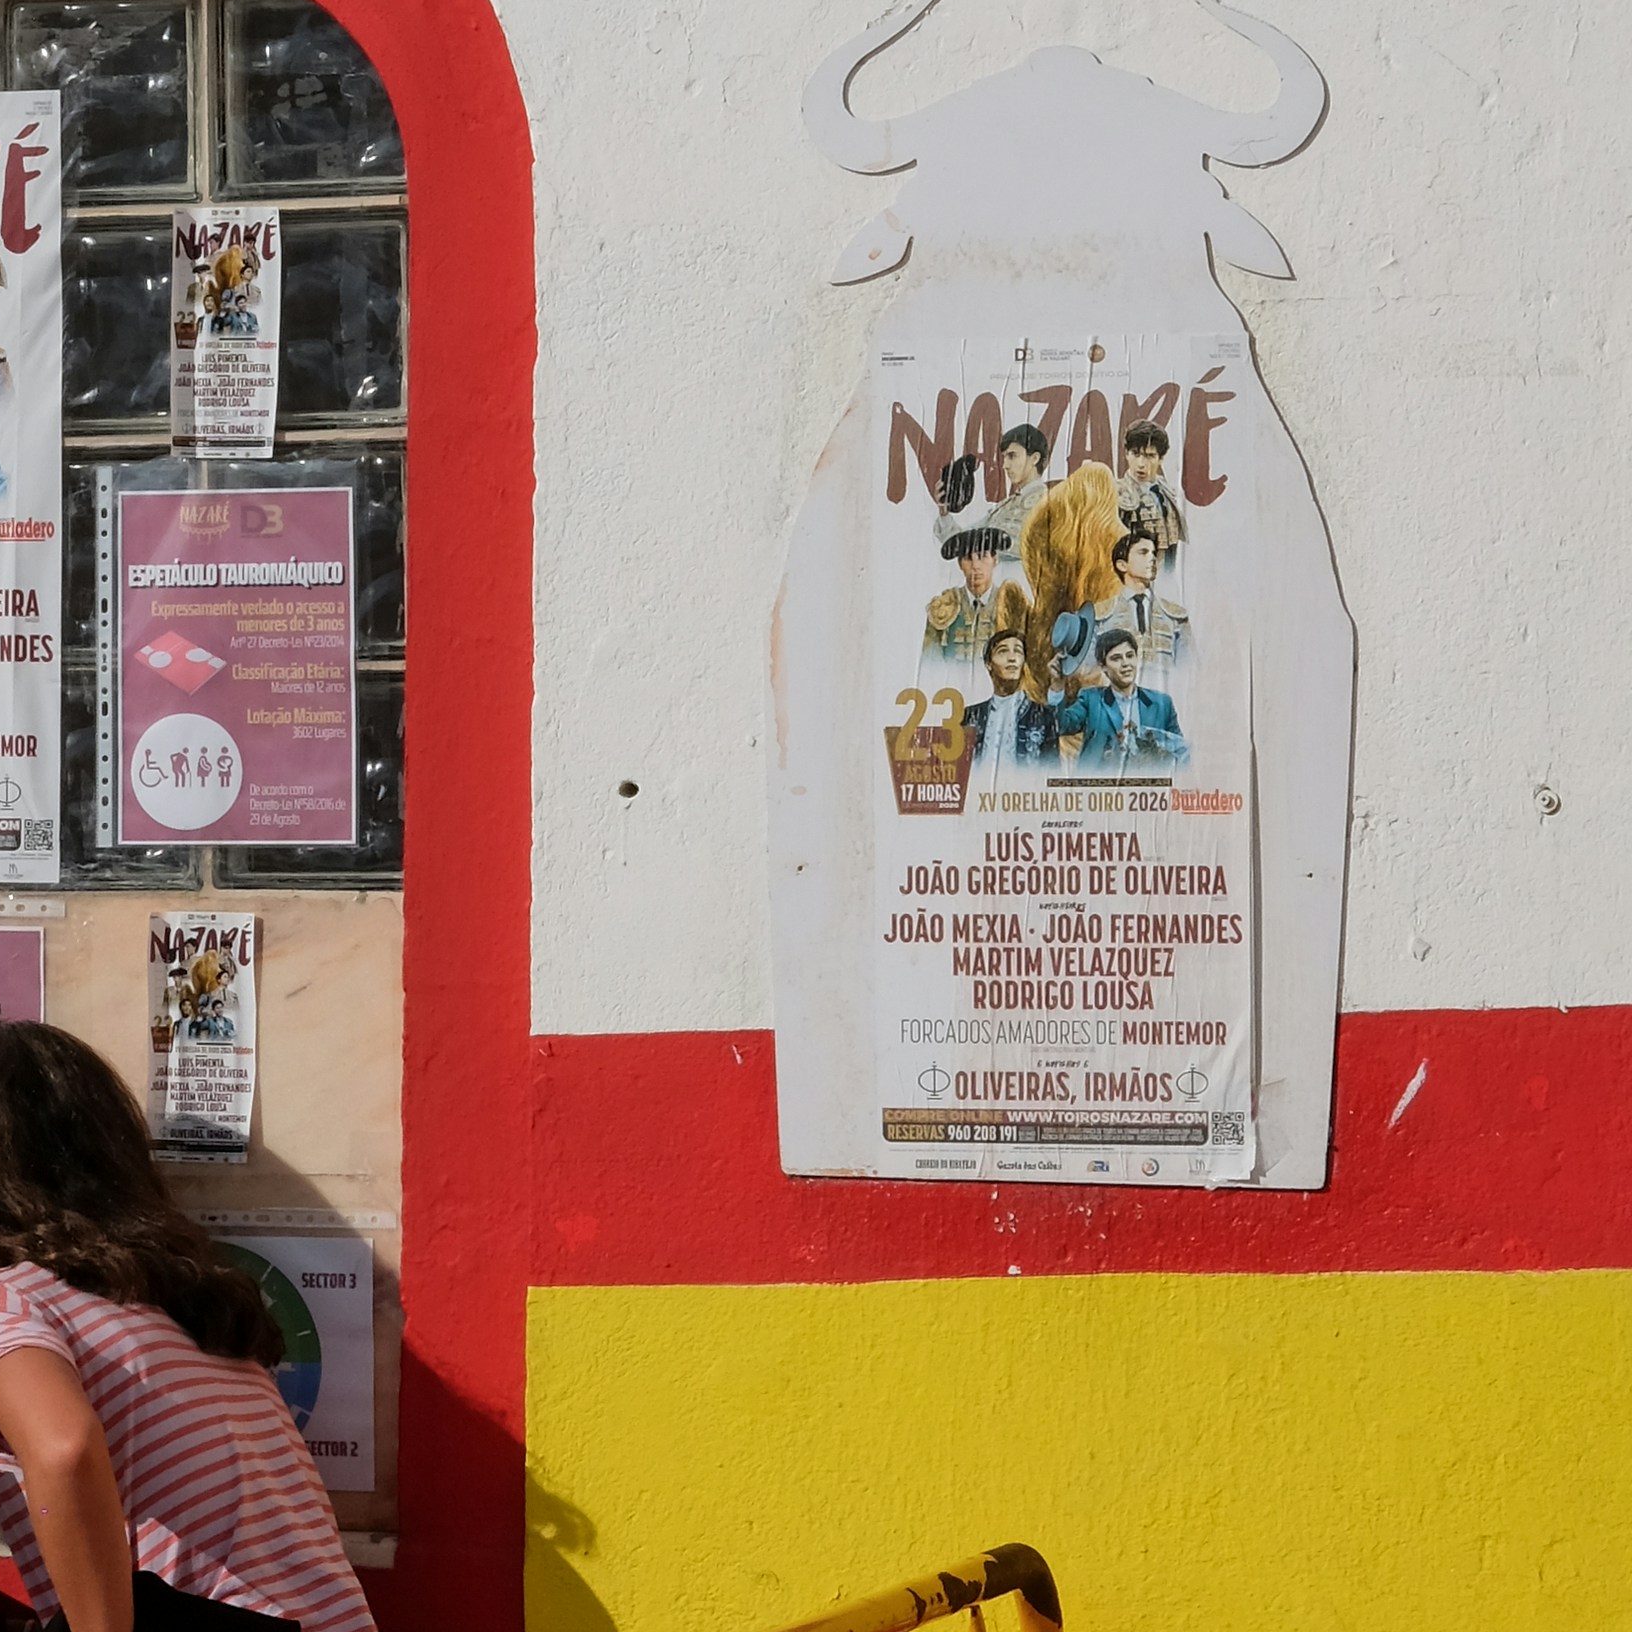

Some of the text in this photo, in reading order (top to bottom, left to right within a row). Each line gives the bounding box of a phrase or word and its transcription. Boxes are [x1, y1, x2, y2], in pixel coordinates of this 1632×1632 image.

[175, 217, 278, 261] NAZARÉ
[886, 365, 1237, 508] NAZARÉ
[128, 556, 344, 588] ESPETÁCULO TAUROMÁQUICO
[247, 706, 346, 726] Lotação Máxima:
[894, 687, 966, 762] 23
[984, 827, 1142, 863] LUÍS PIMENTA
[899, 859, 1228, 896] JOÃO GREGÓRIO DE OLIVEIRA
[883, 906, 1243, 945] JOÃO MEXIA JOÃO FERNANDES
[150, 923, 252, 967] NAZARÉ
[952, 946, 1176, 980] MARTIM VELAZQUEZ
[972, 980, 1155, 1011] RODRIGO LOUSA
[954, 1066, 1173, 1105] OLIVEIRAS, IRMÃOS
[301, 1272, 357, 1290] SECTOR 3
